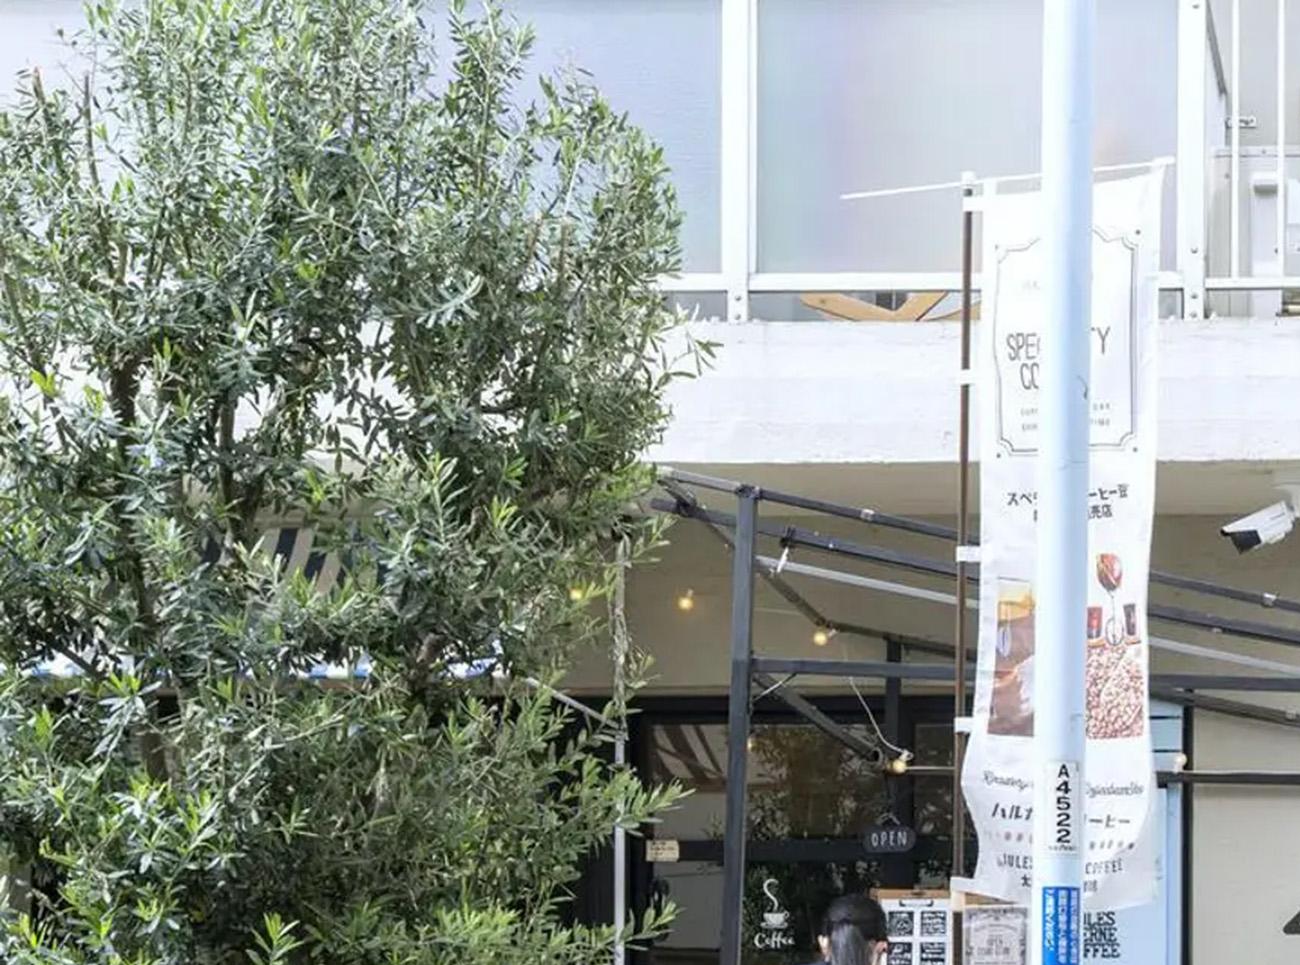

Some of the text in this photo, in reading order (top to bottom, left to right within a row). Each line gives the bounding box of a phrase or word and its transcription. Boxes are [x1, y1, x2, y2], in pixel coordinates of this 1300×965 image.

[1055, 763, 1072, 844] A4522
[871, 831, 908, 848] OPEN
[753, 932, 796, 949] Coffee
